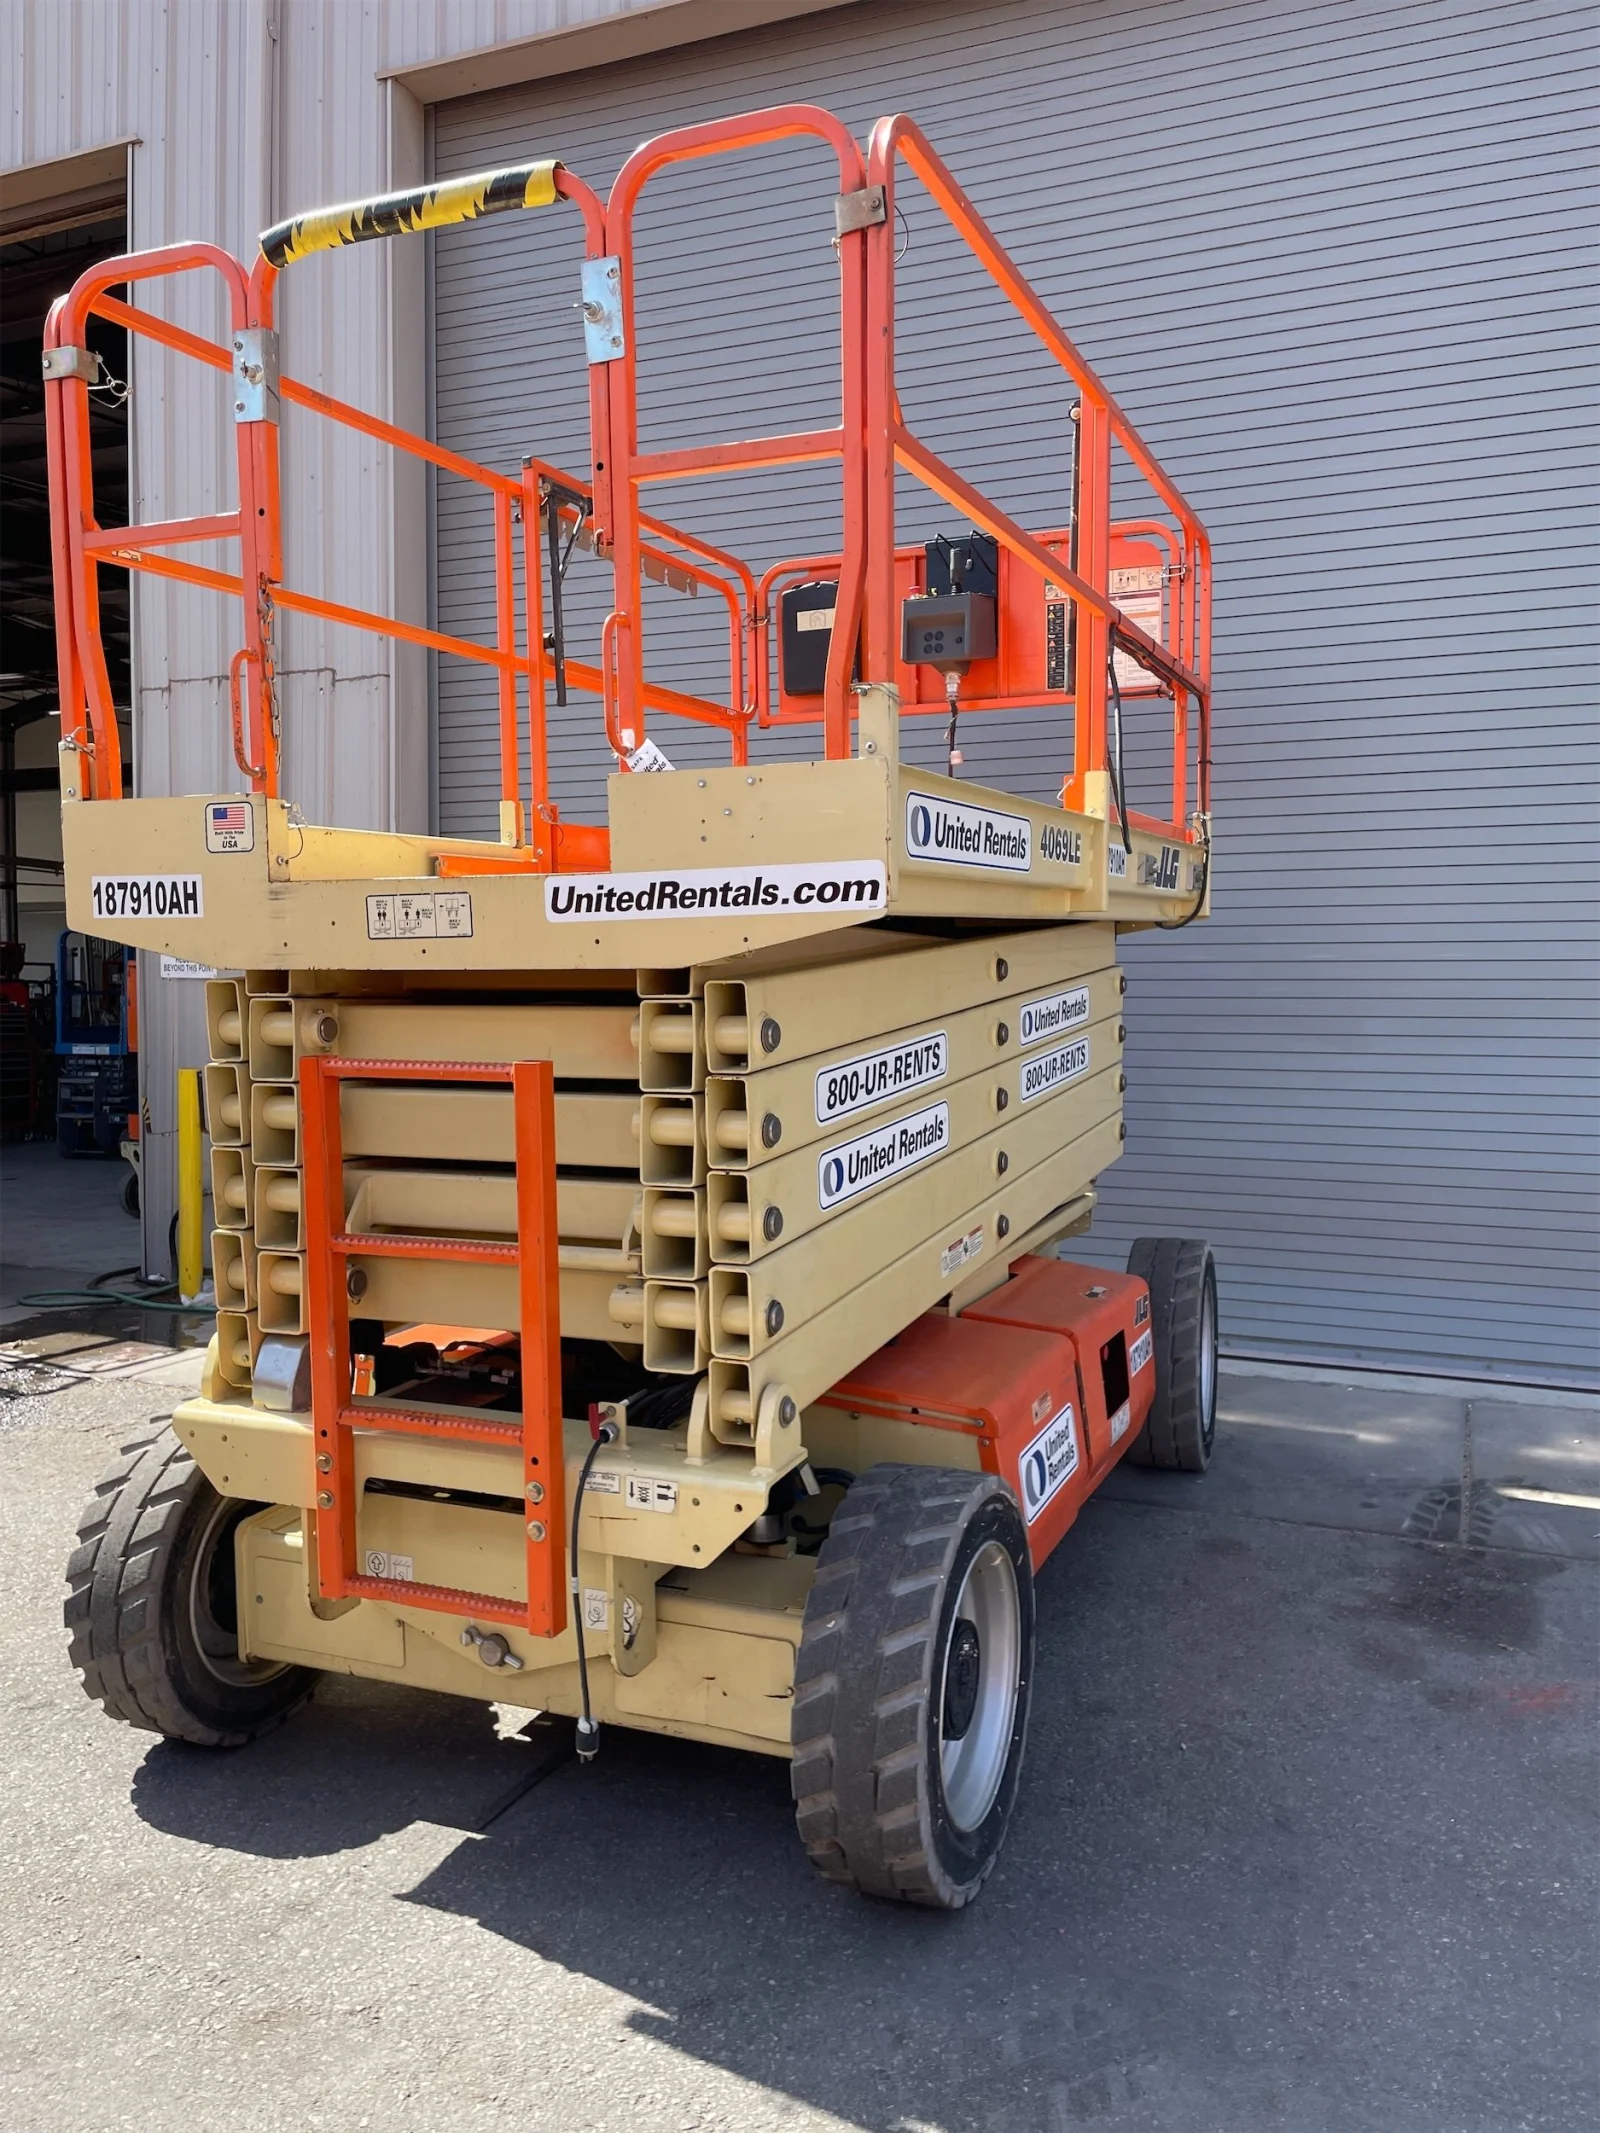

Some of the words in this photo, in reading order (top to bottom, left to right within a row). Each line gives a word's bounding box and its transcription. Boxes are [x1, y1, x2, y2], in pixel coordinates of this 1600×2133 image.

[222, 840, 238, 849] USA
[934, 812, 982, 852] United
[983, 821, 1026, 860] Rentals
[1040, 824, 1081, 864] 4069LE
[1155, 845, 1180, 890] JLG
[93, 880, 199, 916] 187910AH
[551, 876, 880, 914] UnitedRentals.com
[163, 963, 185, 972] BEYOND
[186, 964, 197, 972] THIS
[1034, 1006, 1059, 1032] United
[1061, 998, 1086, 1024] Rentals
[827, 1042, 940, 1111] 800-UR-RENTS
[1025, 1044, 1086, 1092] 800-UR-RENTS
[848, 1134, 895, 1184] United
[899, 1115, 944, 1159] Rentals
[1135, 1293, 1149, 1326] JLG
[1045, 1417, 1070, 1461] United
[1048, 1441, 1075, 1486] Rentals
